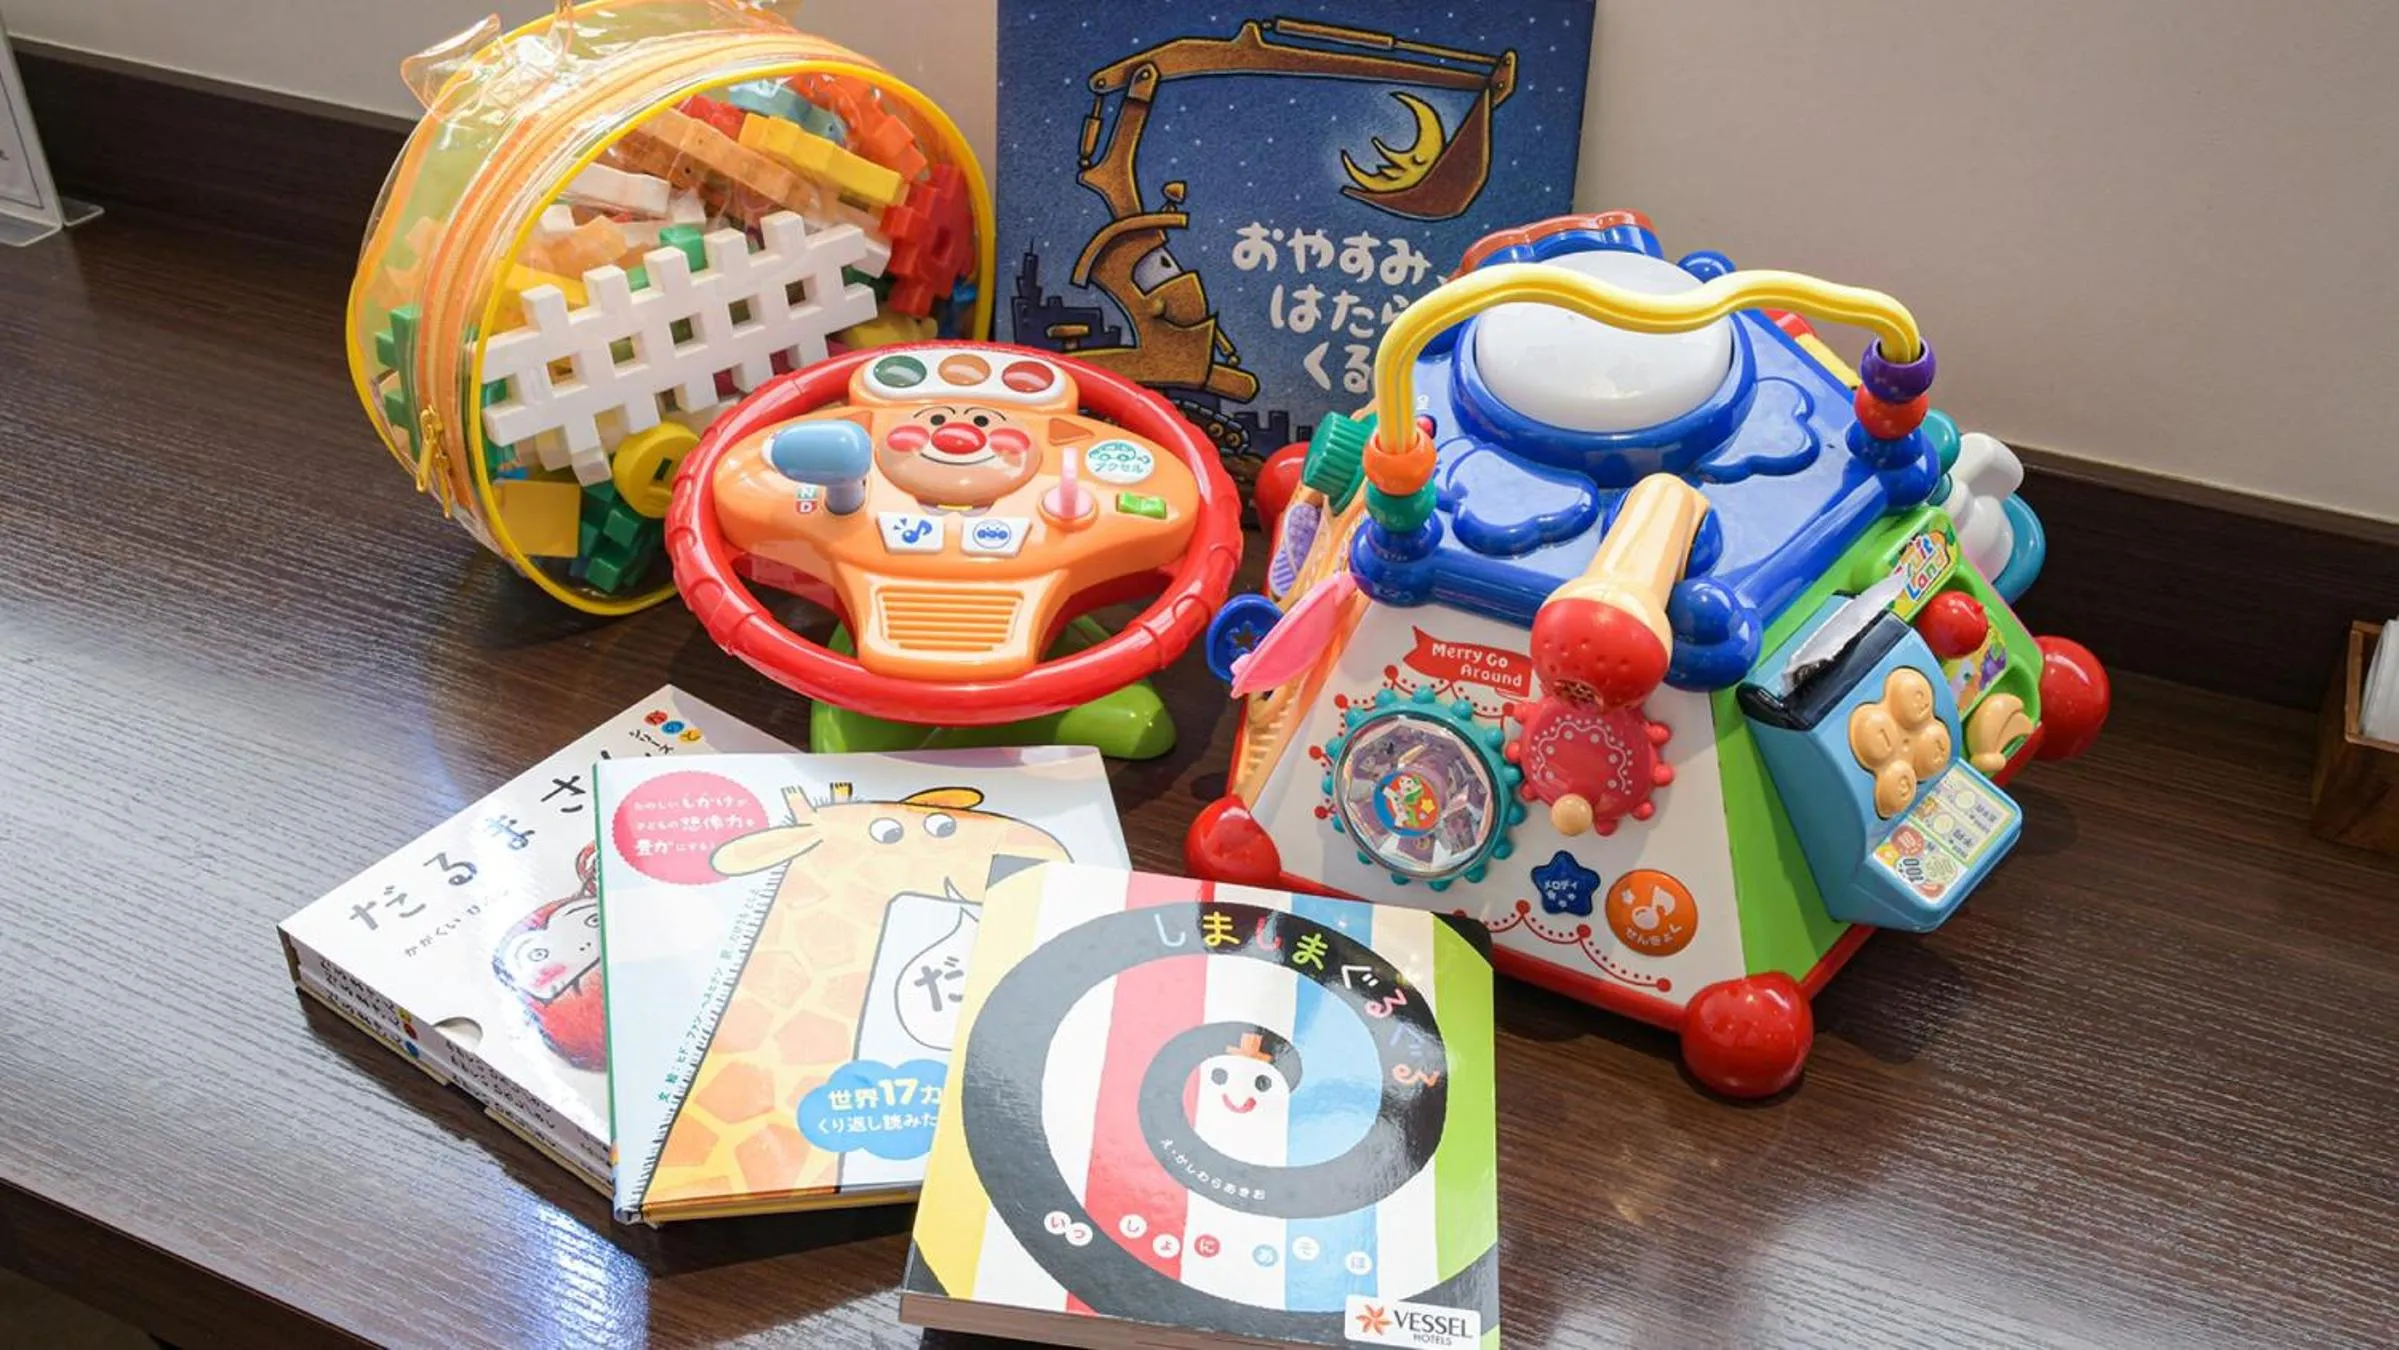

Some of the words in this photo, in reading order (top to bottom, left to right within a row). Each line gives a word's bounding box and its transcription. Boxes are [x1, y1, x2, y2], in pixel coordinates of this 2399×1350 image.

[1095, 461, 1144, 473] アクセル
[800, 501, 813, 513] D
[1905, 545, 1947, 601] Land
[1432, 643, 1483, 663] Merry
[1486, 653, 1509, 668] Go
[1461, 664, 1522, 687] Around
[629, 729, 674, 755] シリーズ
[350, 750, 612, 930] だるまさ
[1544, 880, 1578, 890] メロディ
[1626, 923, 1683, 946] せんきょく
[914, 956, 964, 1012] だ
[1153, 911, 1441, 1088] しましまぐるぐる
[1393, 1310, 1474, 1339] VESSEL
[1413, 1333, 1452, 1346] HOTELS
